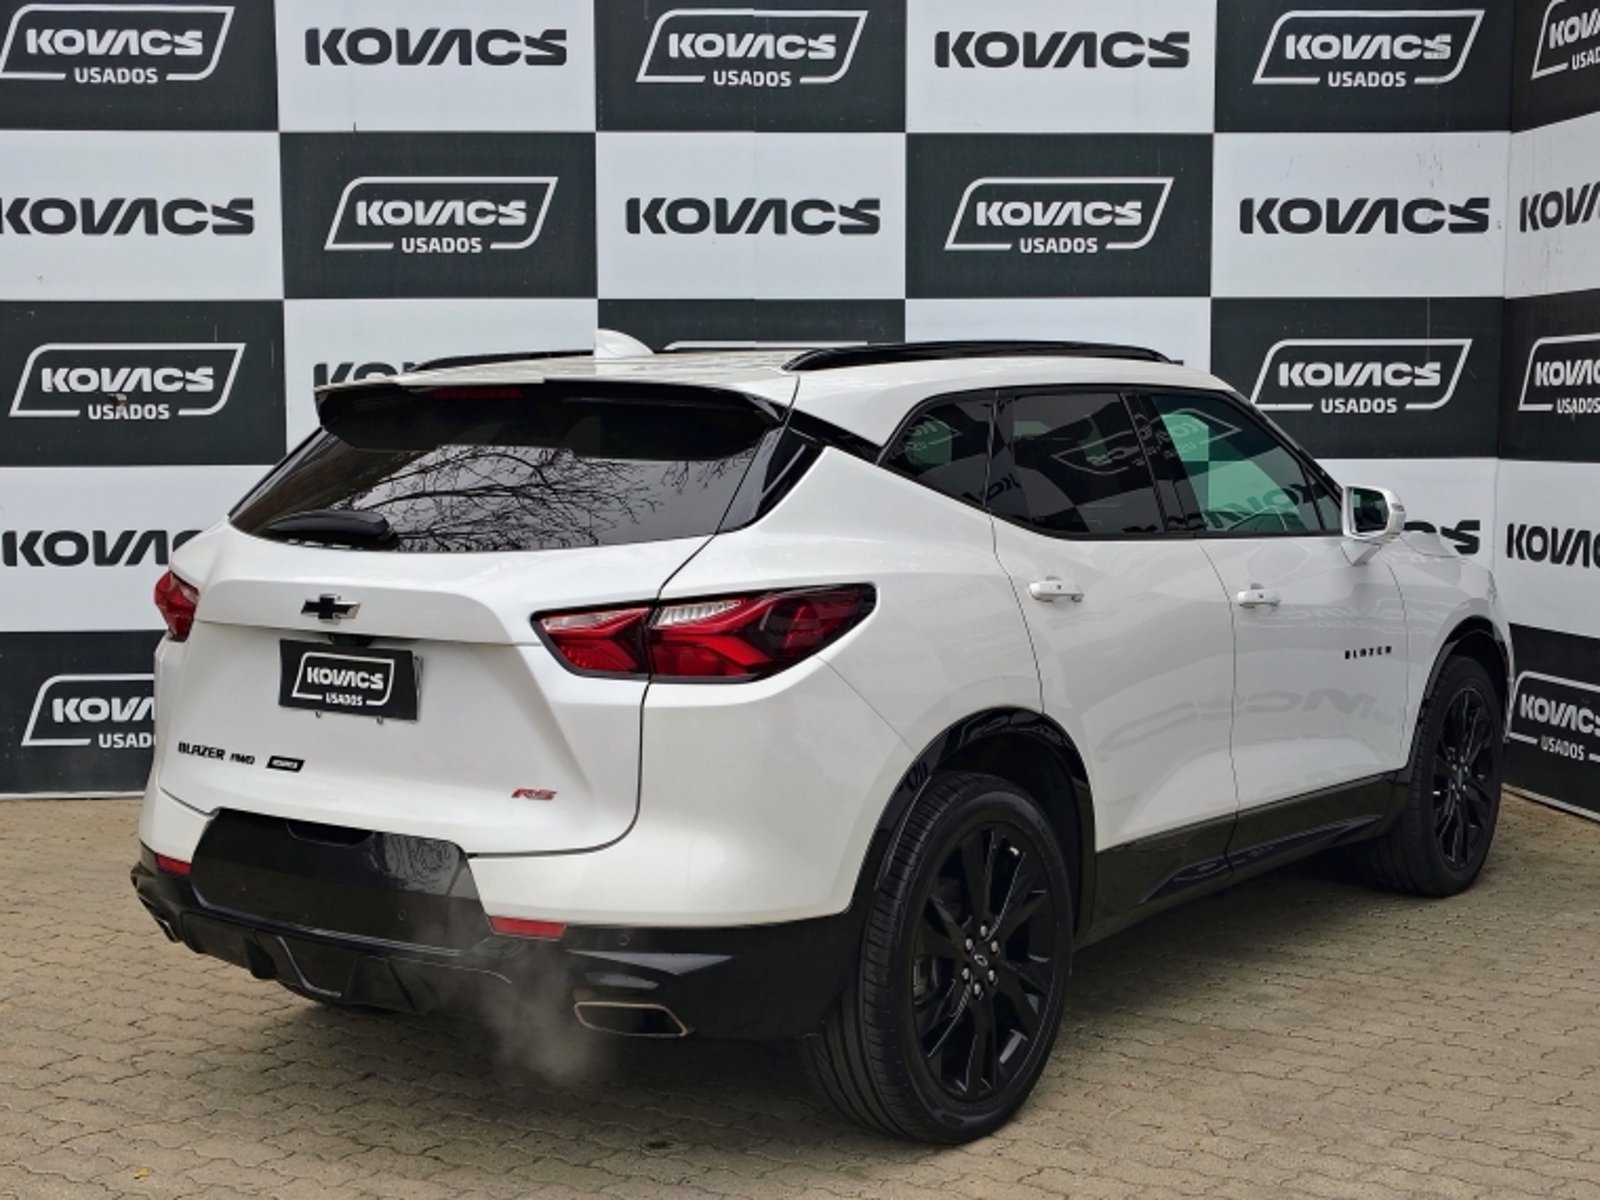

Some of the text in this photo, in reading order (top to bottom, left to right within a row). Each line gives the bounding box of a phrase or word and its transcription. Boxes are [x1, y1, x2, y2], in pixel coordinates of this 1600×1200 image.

[26, 28, 203, 56] KOVACS
[304, 27, 567, 66] KOVACS
[668, 33, 836, 60] KOVACS
[934, 31, 1190, 69] KOVACS
[1285, 34, 1452, 60] KOVACS
[74, 66, 159, 84] USADOS
[713, 70, 792, 87] USADOS
[1327, 71, 1407, 88] USADOS
[0, 197, 255, 236] KOVACS
[356, 200, 527, 226] KOVACS
[625, 197, 881, 236] KOVACS
[976, 201, 1142, 226] KOVACS
[1239, 197, 1490, 235] KOVACS
[401, 237, 483, 254] USADOS
[1019, 237, 1098, 254] USADOS
[41, 367, 214, 393] KOVACS
[1278, 361, 1441, 387] KOVACS
[1320, 397, 1398, 414] USADOS
[1506, 523, 1600, 569] KOVA
[306, 666, 384, 690] KOVACS
[98, 732, 156, 748] USAD
[177, 741, 226, 760] BLAZER
[1541, 735, 1584, 761] USADOS
